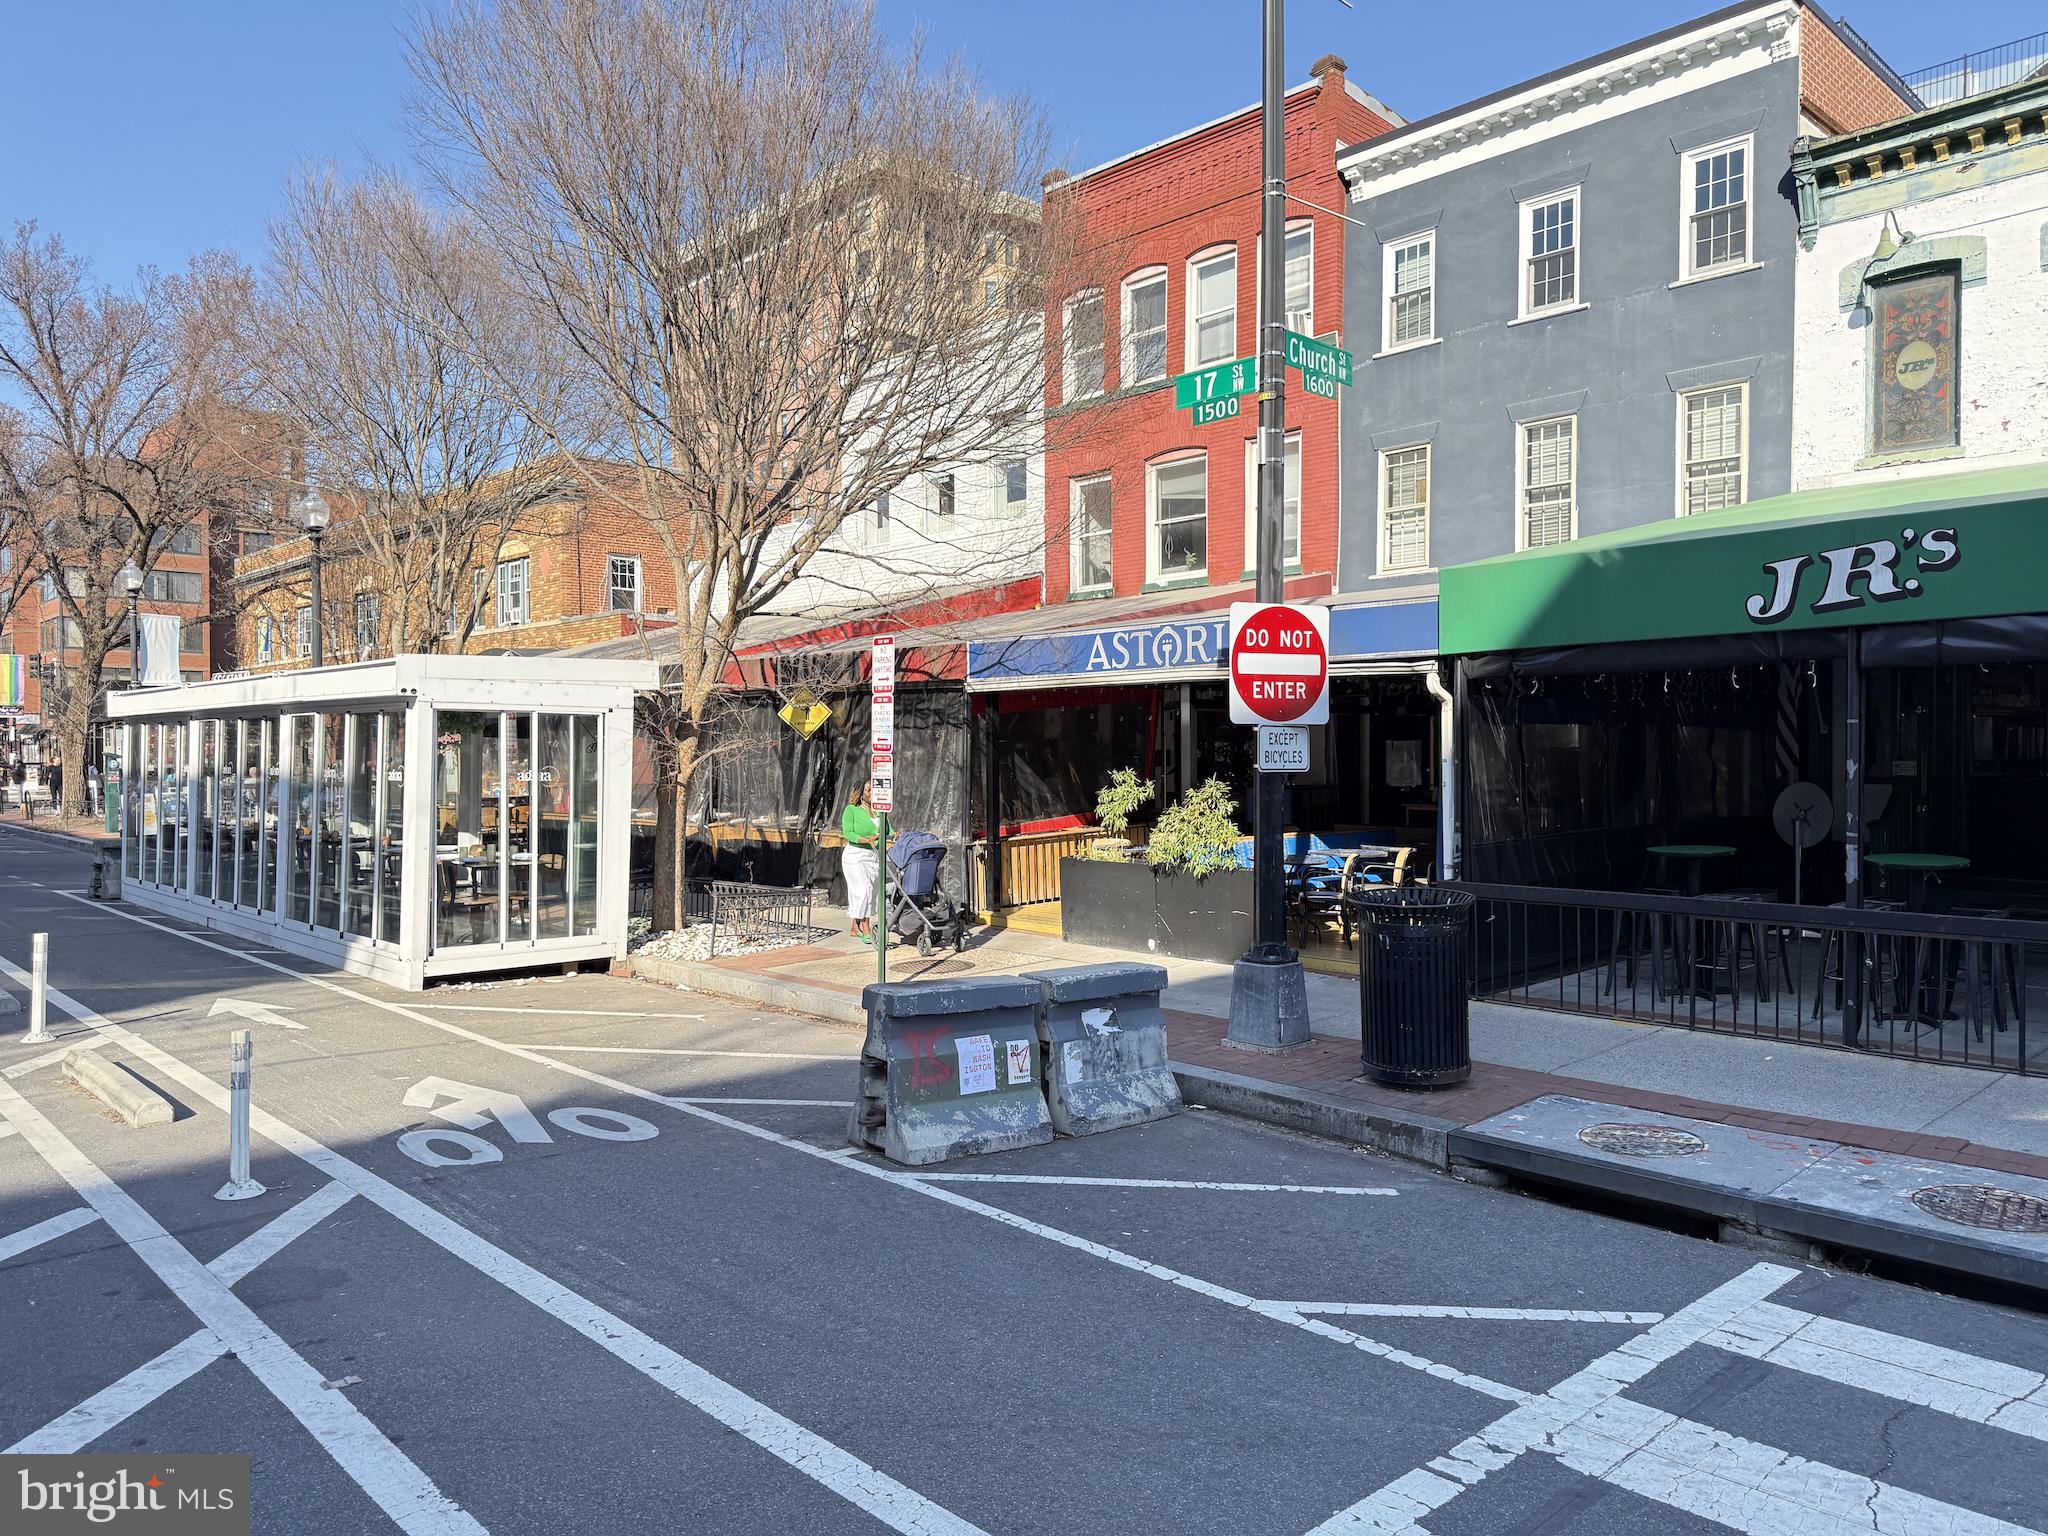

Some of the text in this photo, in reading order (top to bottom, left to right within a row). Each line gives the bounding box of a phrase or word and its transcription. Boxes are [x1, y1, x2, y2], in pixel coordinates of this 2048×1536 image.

[1289, 337, 1347, 381] Church St NW
[1194, 363, 1244, 400] 17 St NW
[1305, 373, 1334, 398] 1600
[1197, 397, 1238, 423] 1500
[1085, 623, 1226, 671] ASTORI
[1245, 628, 1313, 648] DO NOT
[1252, 681, 1307, 700] ENTER
[1268, 732, 1299, 746] EXCEPT
[1264, 750, 1303, 764] BICYCLES
[968, 1036, 989, 1046] WAKE
[972, 1053, 991, 1063] WASH
[964, 1063, 993, 1074] INGTON
